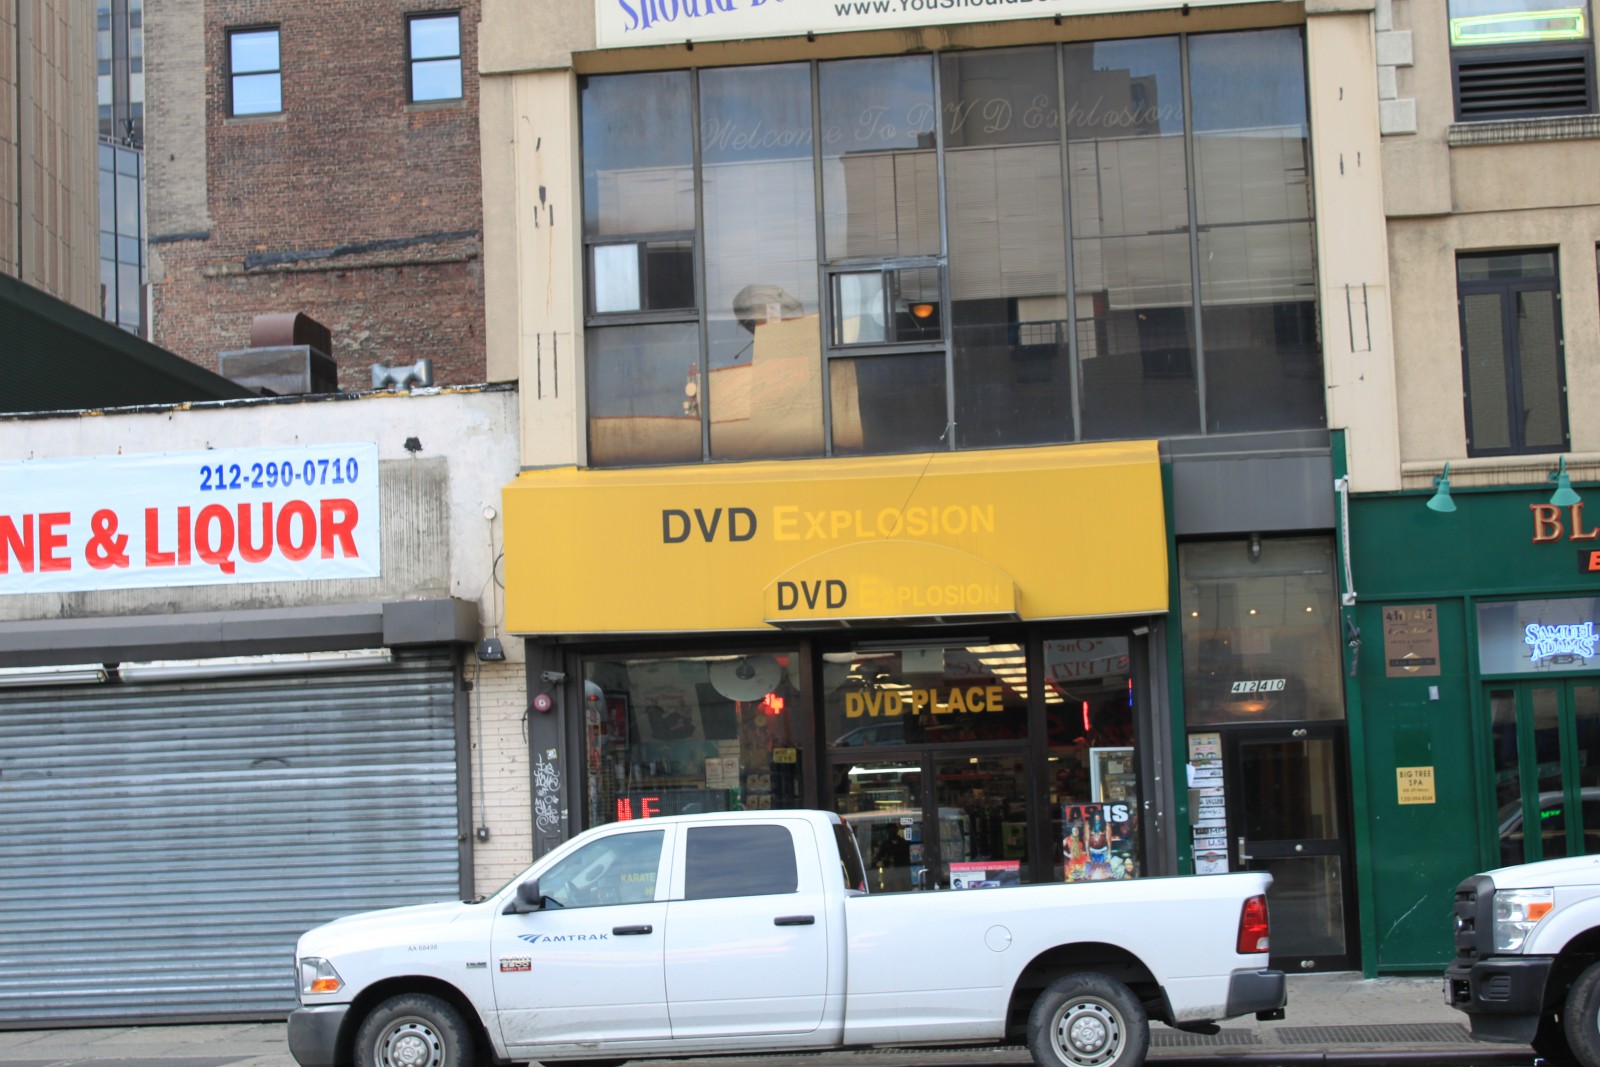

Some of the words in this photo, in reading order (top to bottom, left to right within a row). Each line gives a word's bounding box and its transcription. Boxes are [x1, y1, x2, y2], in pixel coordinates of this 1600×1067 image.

[199, 457, 359, 491] 212-290-0710
[0, 512, 72, 574] NE
[85, 509, 130, 570] &
[144, 498, 359, 575] LIQUOR
[661, 507, 758, 544] DVD
[776, 579, 849, 611] DVD
[1524, 621, 1600, 645] SAMUEL
[1530, 639, 1595, 662] ADAMS
[1233, 681, 1257, 691] 412
[1260, 680, 1285, 690] 410
[845, 690, 906, 718] DVD
[911, 686, 1004, 716] PLACE
[1415, 770, 1432, 778] TREE
[1102, 804, 1129, 823] IS
[541, 932, 609, 943] AMTRAK
